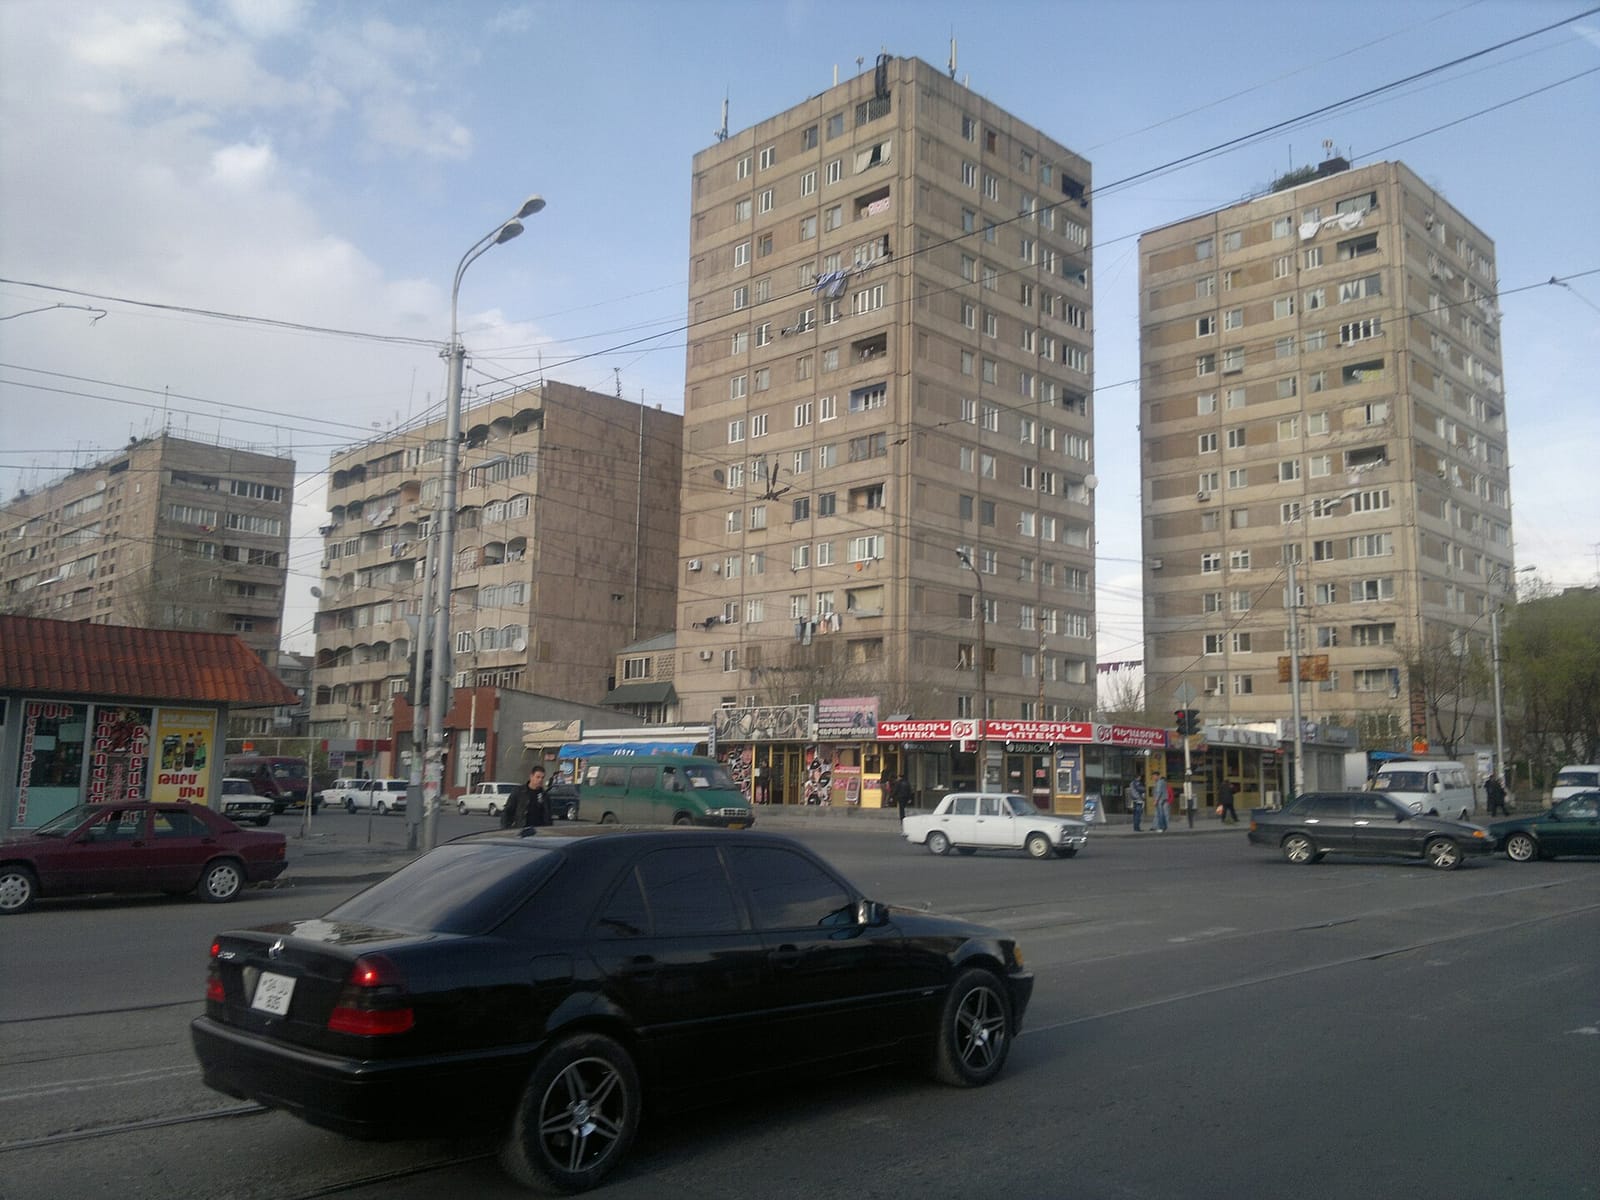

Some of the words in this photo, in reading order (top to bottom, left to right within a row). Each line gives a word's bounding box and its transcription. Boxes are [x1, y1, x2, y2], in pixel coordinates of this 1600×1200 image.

[881, 723, 949, 732] ԴԵՂԱՏՈՒՆ
[988, 722, 1083, 733] ԴԵՂԱՏՈՒՆ
[894, 731, 936, 739] АПТЕКА
[1005, 731, 1066, 740] АПТЕКА
[158, 774, 198, 785] ԹԱՐՄ
[179, 787, 205, 798] ՄԻՍ
